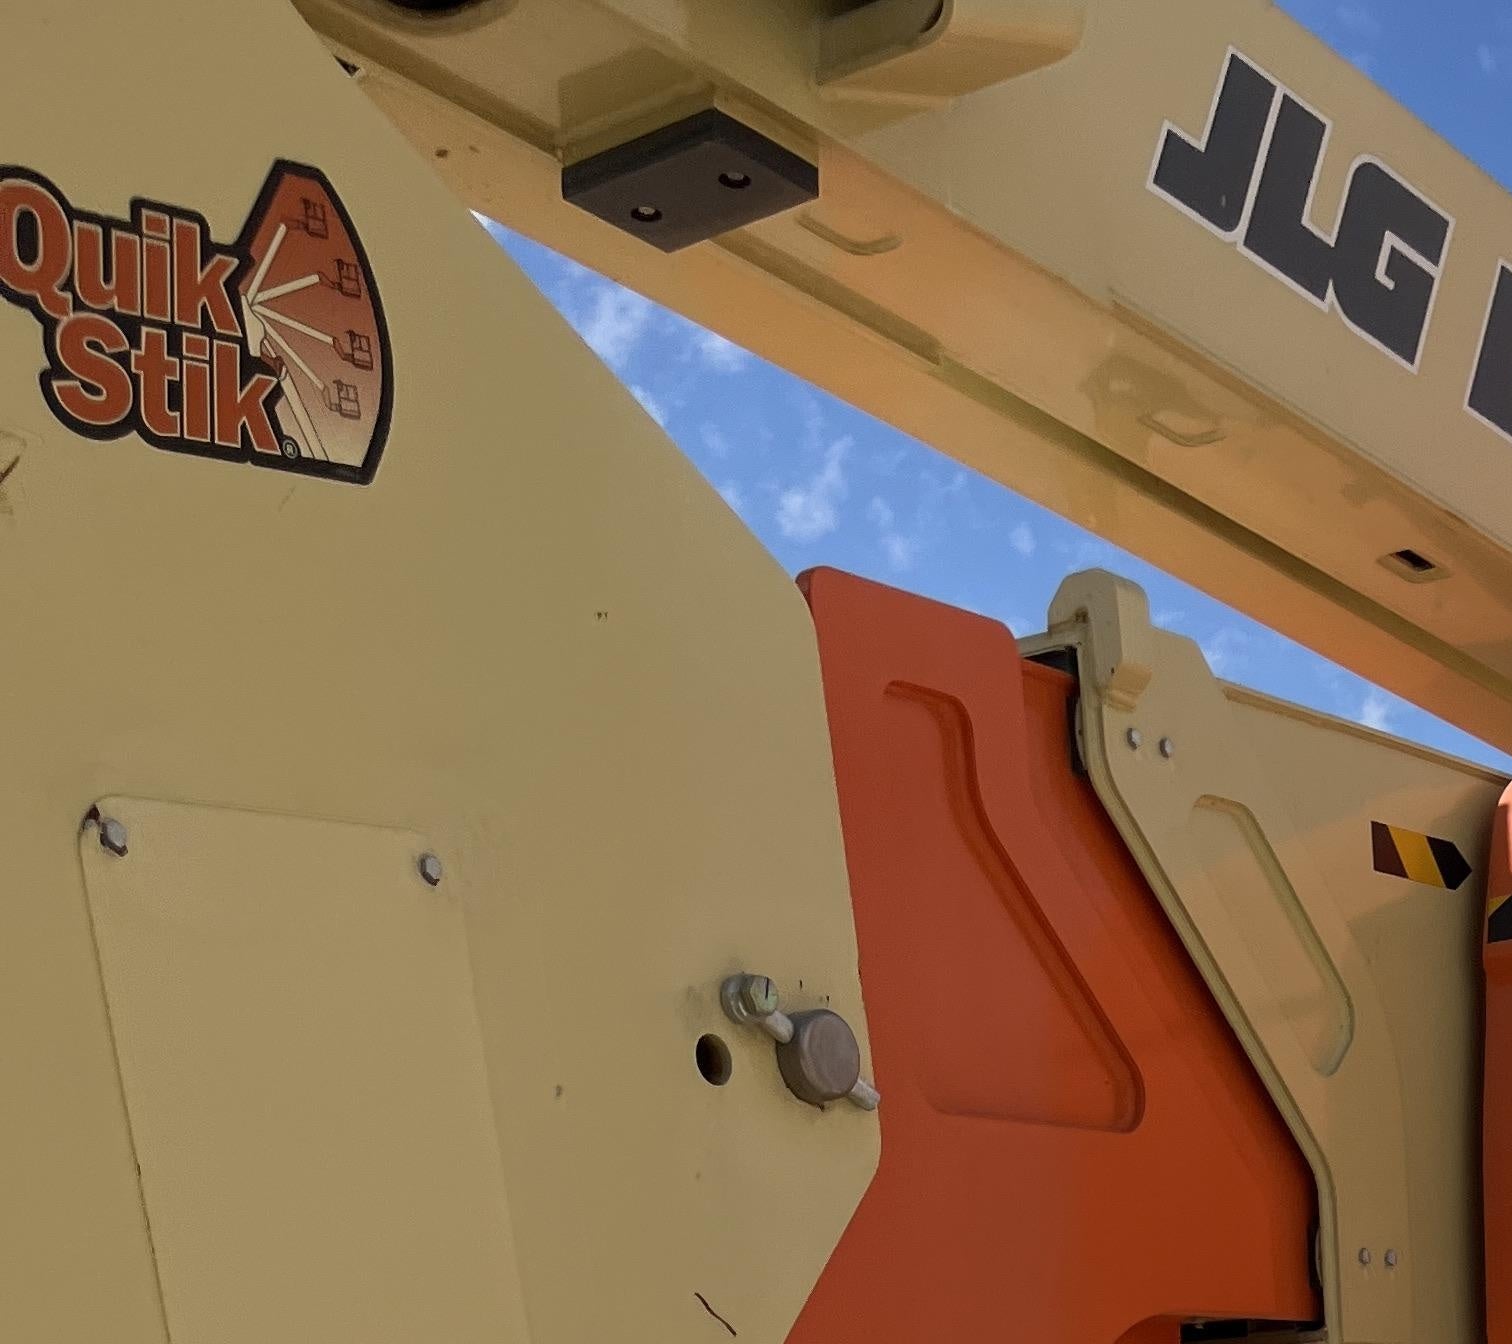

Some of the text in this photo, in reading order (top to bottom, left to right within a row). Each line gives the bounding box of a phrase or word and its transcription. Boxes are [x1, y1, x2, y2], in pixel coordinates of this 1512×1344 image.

[0, 176, 243, 338] Quik
[1147, 45, 1455, 374] JLG
[51, 312, 282, 457] Stik
